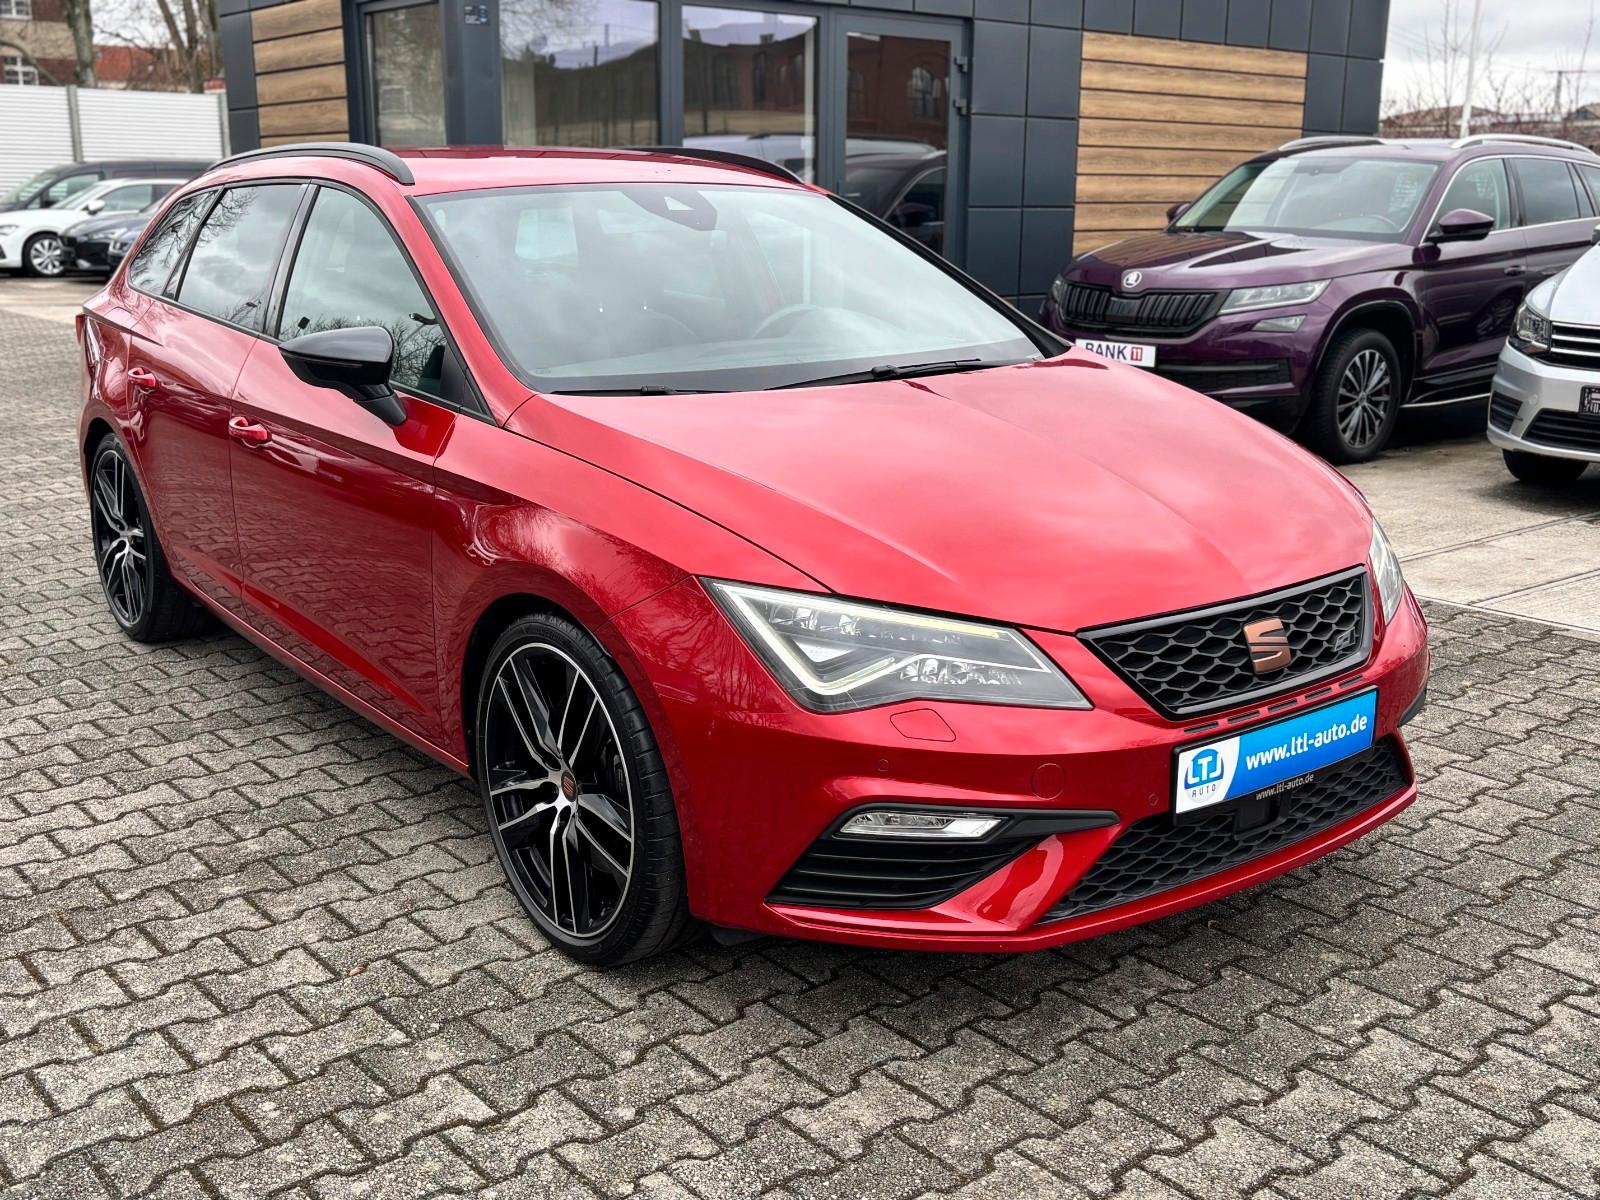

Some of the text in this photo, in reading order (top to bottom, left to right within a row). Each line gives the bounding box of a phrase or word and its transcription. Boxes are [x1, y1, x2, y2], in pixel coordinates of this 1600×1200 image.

[1245, 713, 1368, 770] www.ltl-auto.de
[1191, 783, 1217, 798] AUTO
[1255, 773, 1314, 801] www.ltl-auto.de
